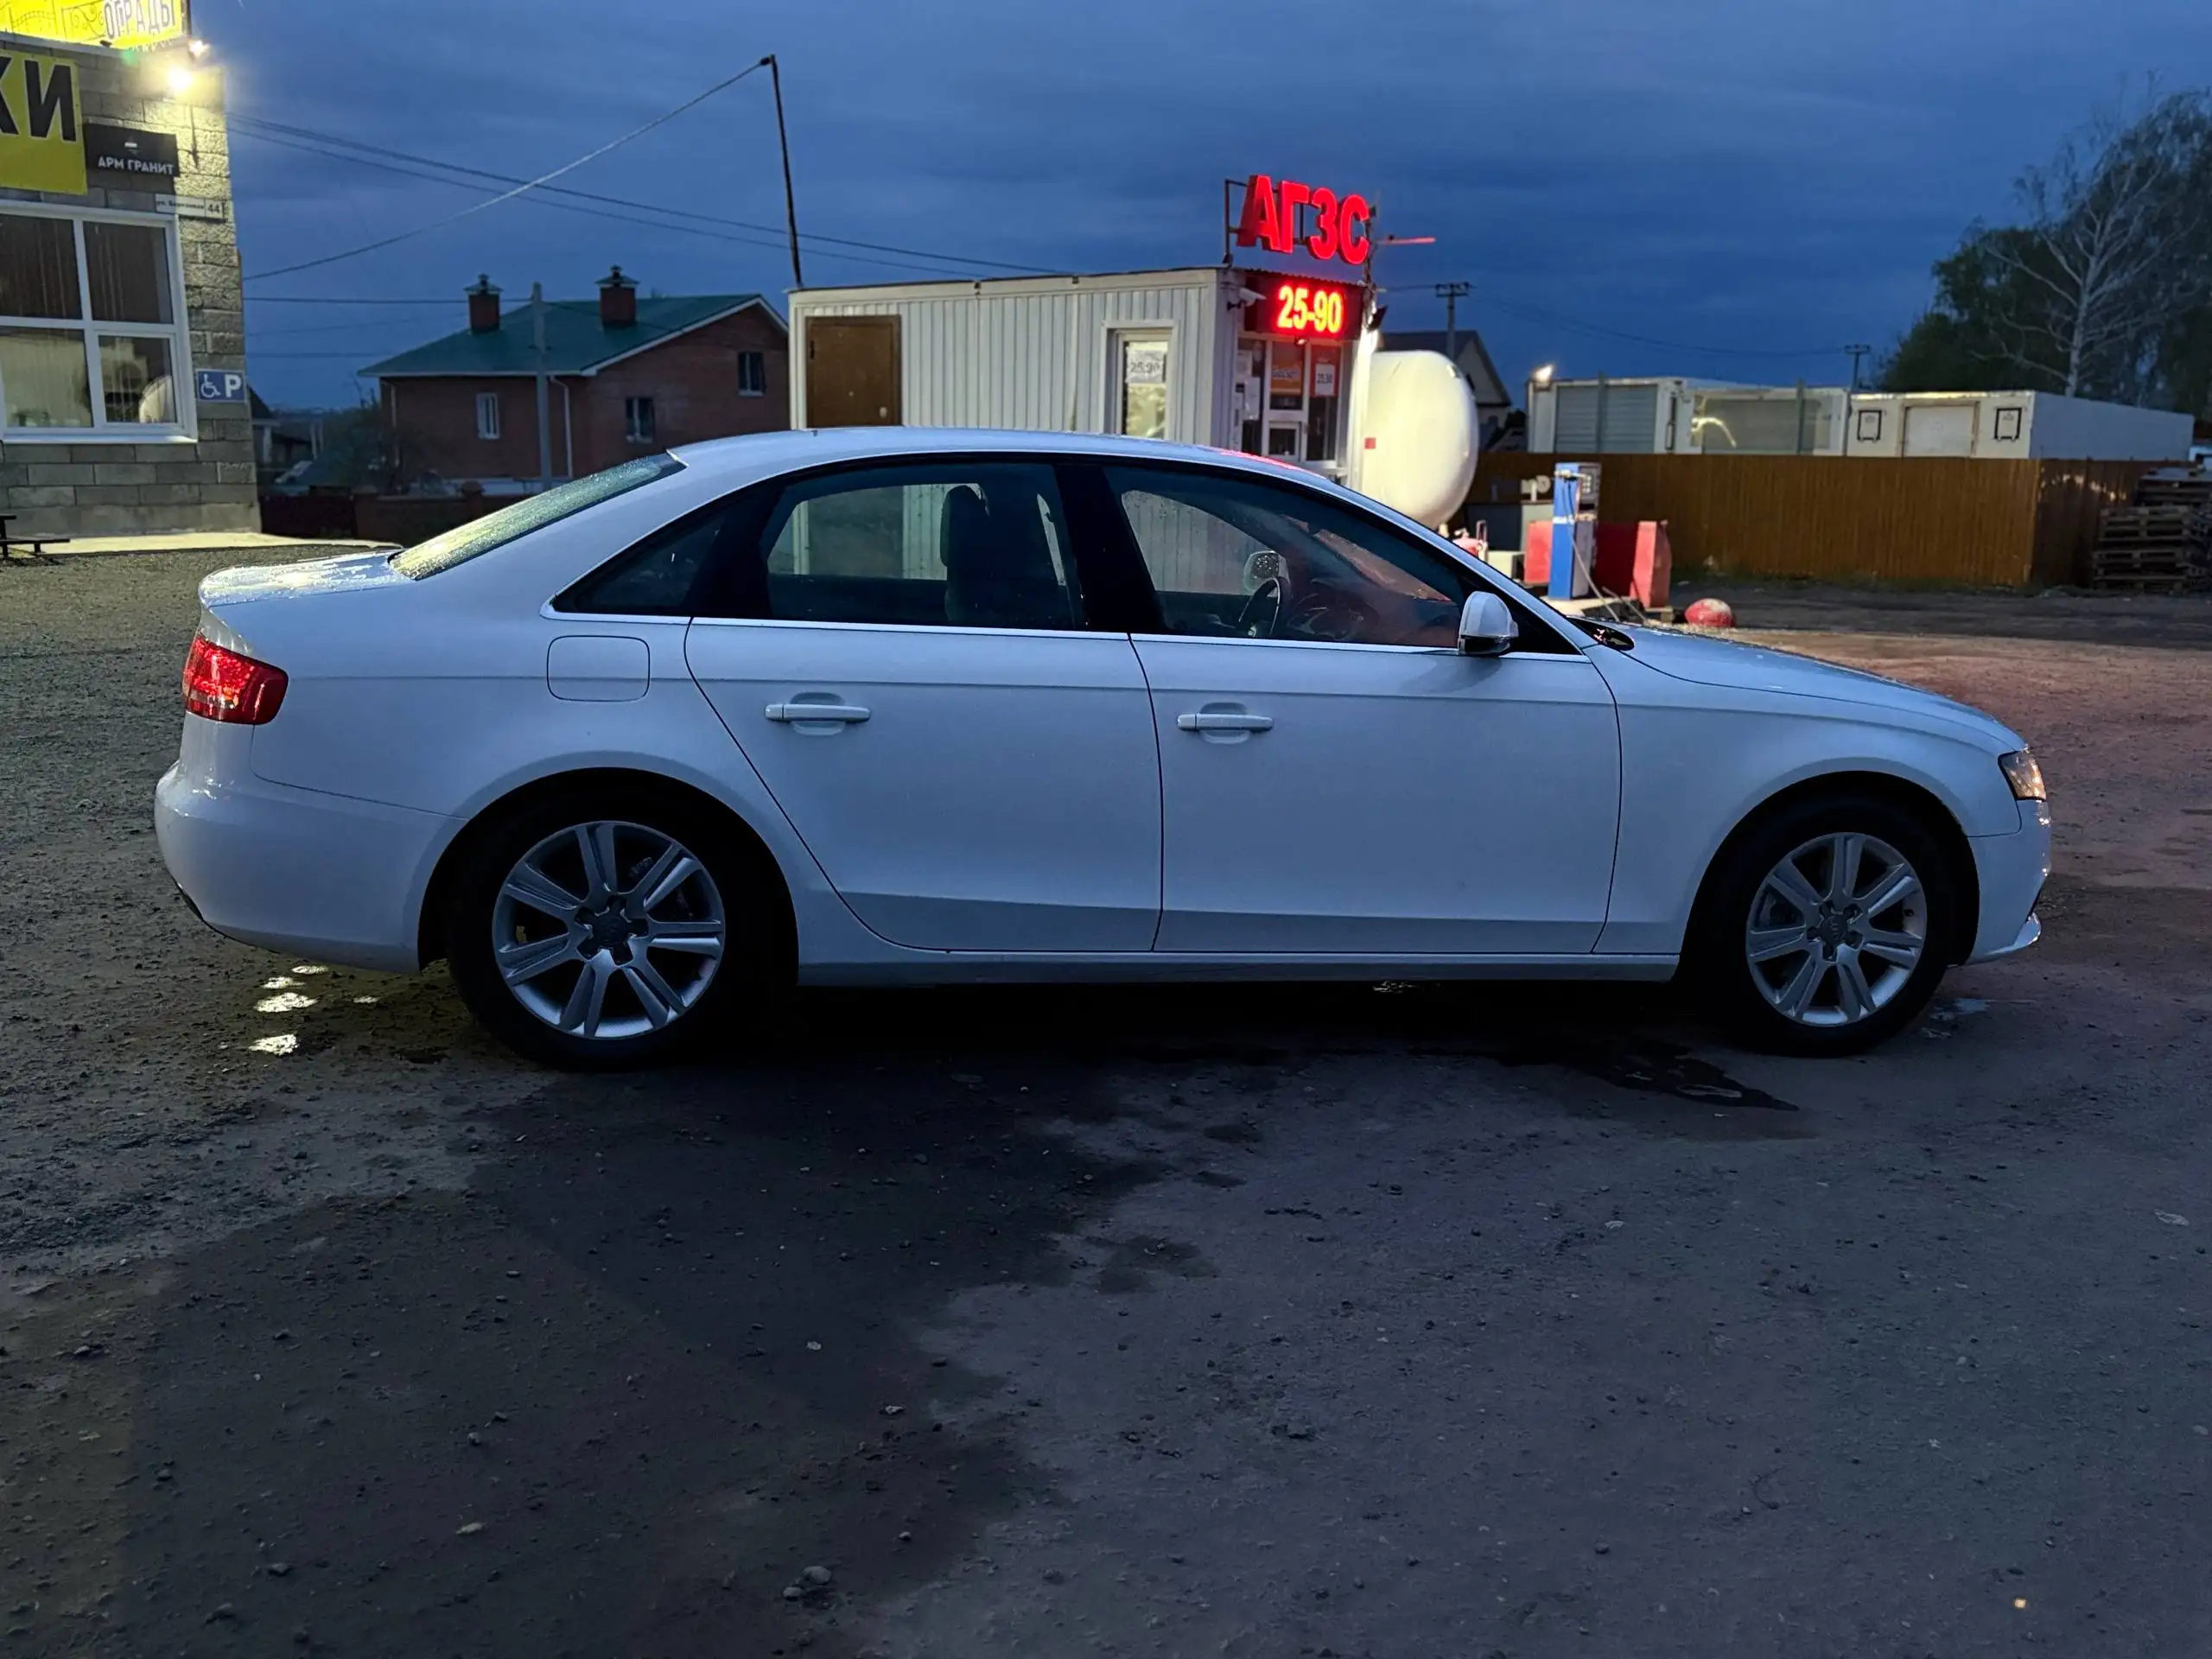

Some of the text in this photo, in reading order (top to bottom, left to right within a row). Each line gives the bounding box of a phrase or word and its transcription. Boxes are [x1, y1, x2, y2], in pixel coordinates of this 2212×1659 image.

[104, 0, 175, 39] ОГРАДЫ
[98, 156, 175, 175] АРМ ГРАНИТ
[207, 203, 220, 213] 44
[1239, 175, 1370, 264] АГЗС
[1277, 285, 1342, 333] 25-90
[226, 374, 242, 397] P
